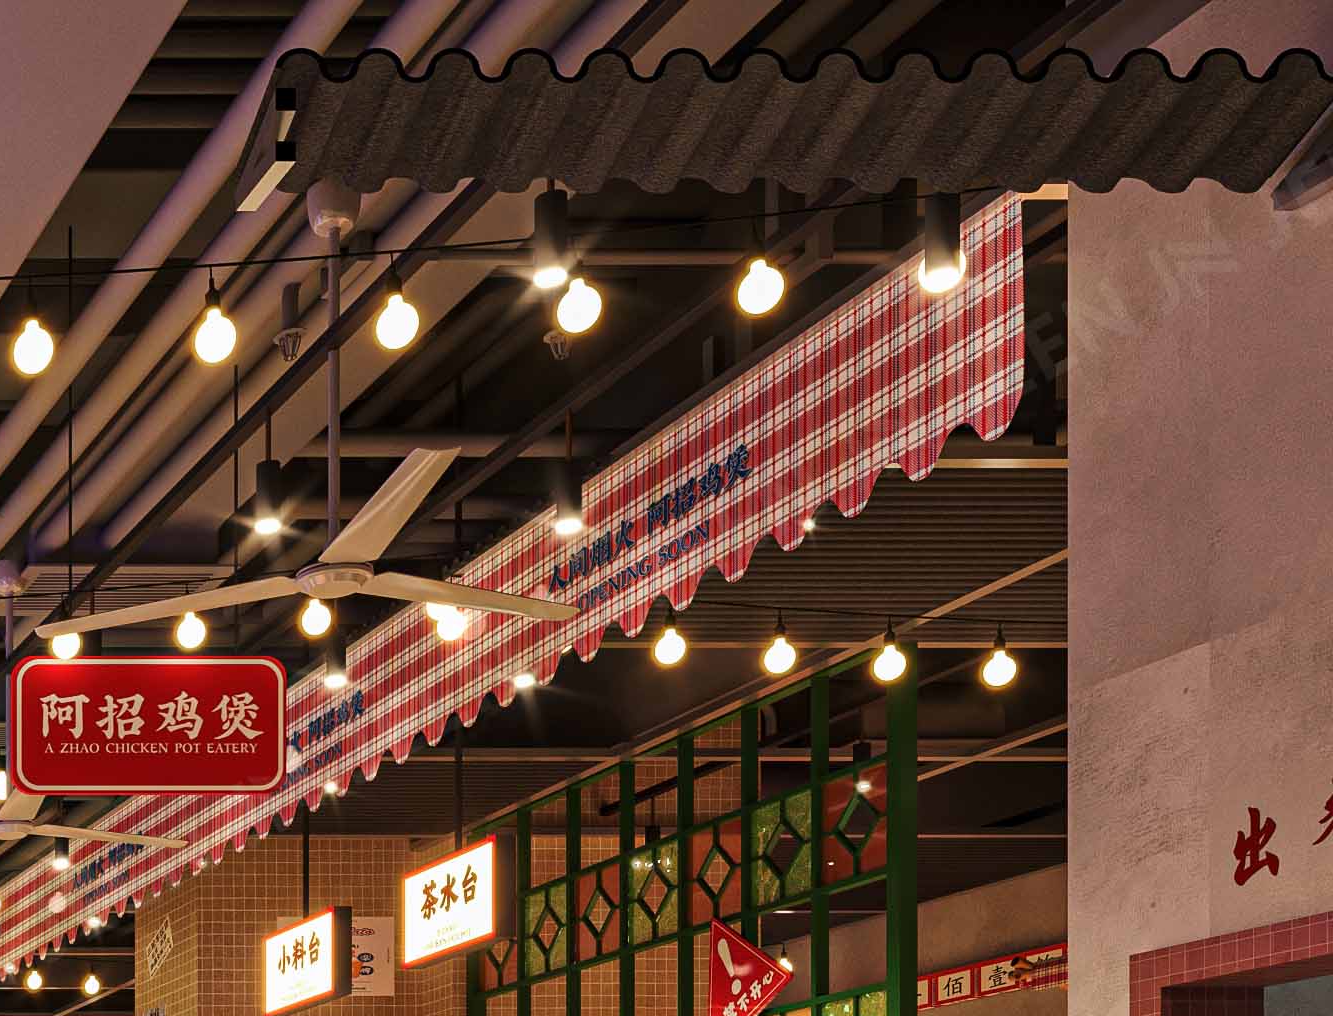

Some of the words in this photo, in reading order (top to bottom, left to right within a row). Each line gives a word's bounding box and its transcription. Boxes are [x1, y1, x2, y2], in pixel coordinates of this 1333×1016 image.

[647, 444, 753, 535] 阿招鸡煲
[658, 519, 711, 566] SOON
[39, 690, 265, 740] 阿招鸡煲
[44, 743, 54, 754] A
[60, 743, 100, 754] ZHAO
[105, 743, 169, 754] CHICKEN
[174, 743, 201, 754] POT
[206, 743, 258, 754] EATERY
[421, 864, 478, 921] 茶水台
[278, 930, 322, 976] 小料台
